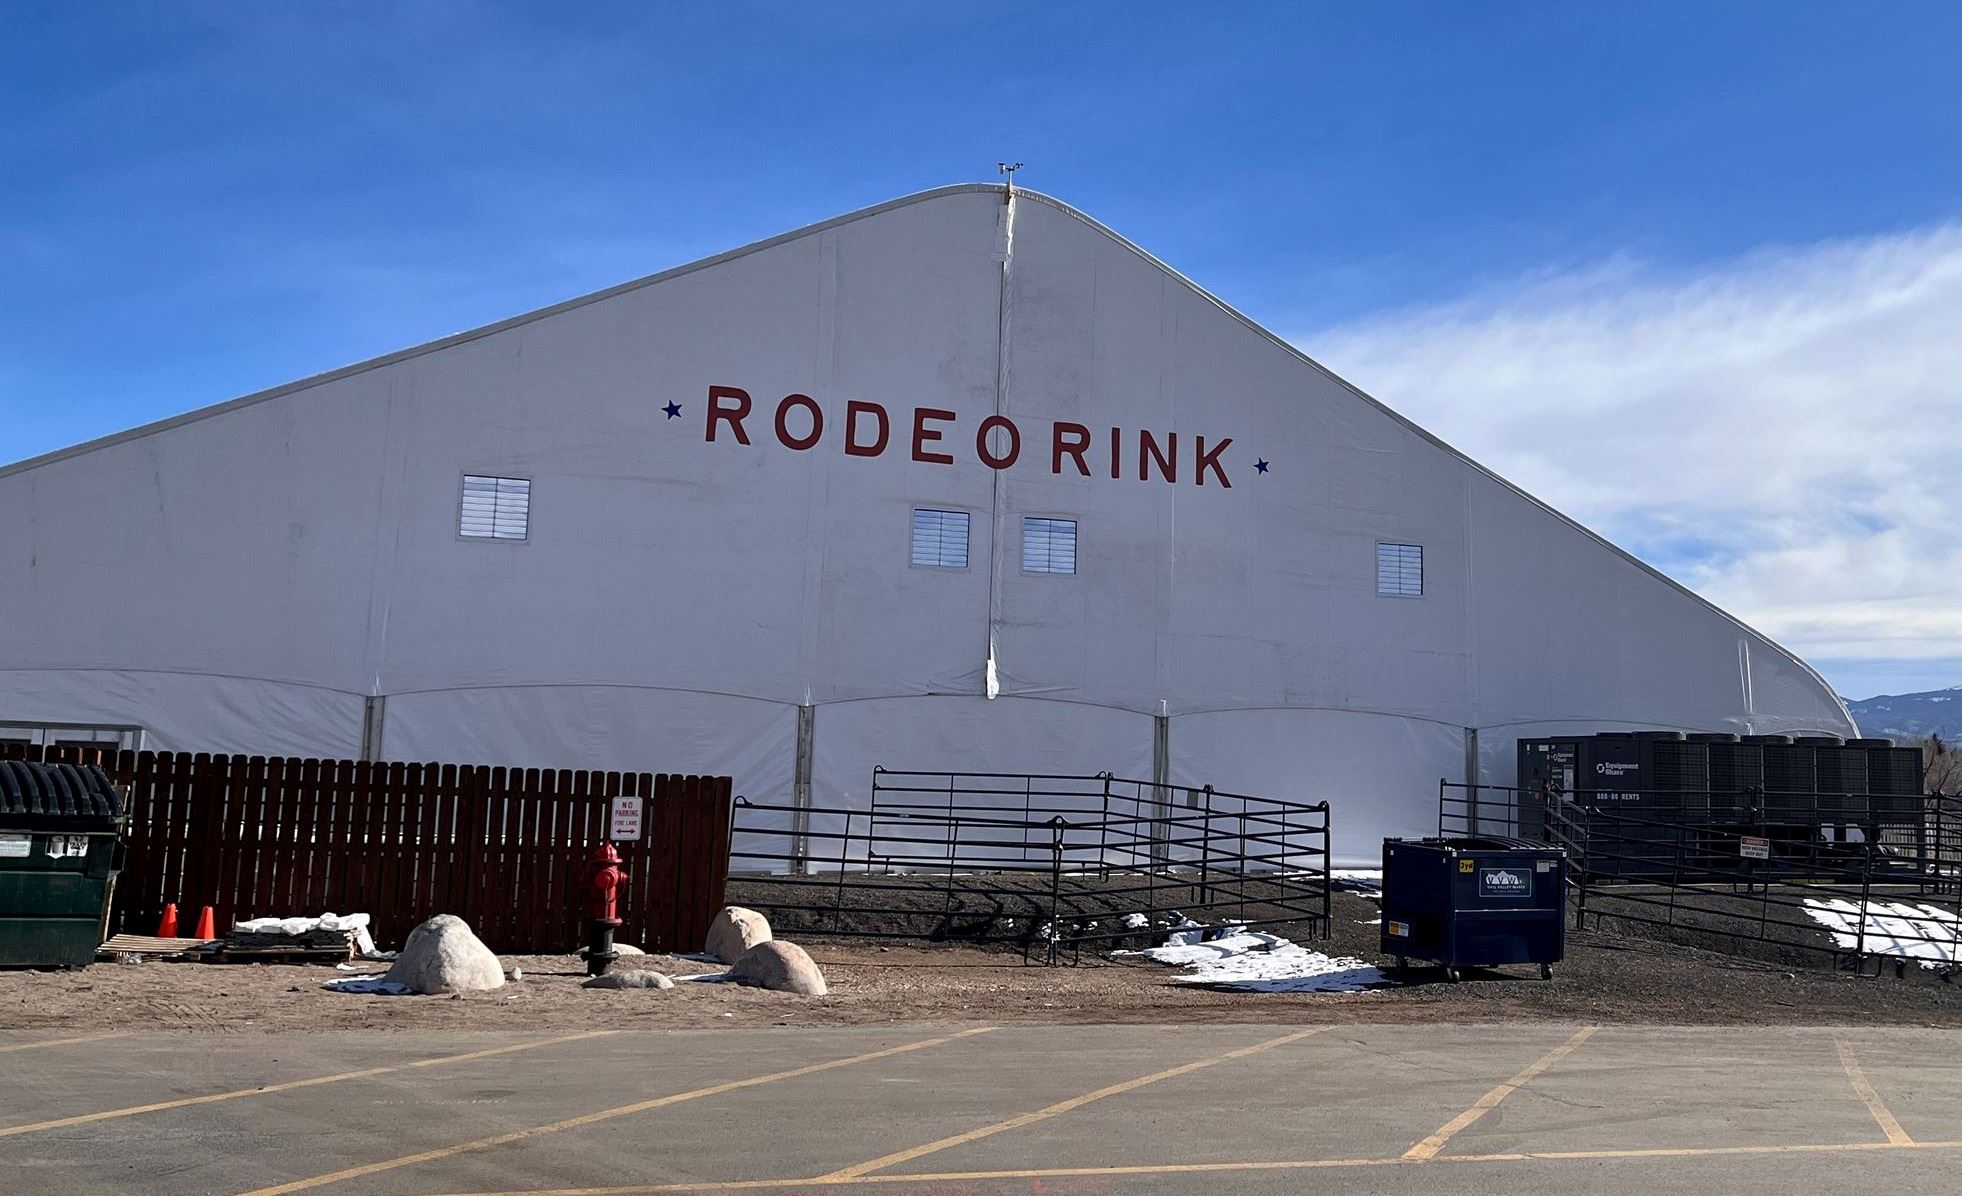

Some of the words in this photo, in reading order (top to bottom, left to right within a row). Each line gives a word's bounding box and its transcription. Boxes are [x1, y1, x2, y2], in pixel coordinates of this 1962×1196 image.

[705, 385, 1021, 470] RODEO
[1051, 421, 1234, 488] RINK
[1605, 762, 1639, 770] Equipment
[622, 801, 633, 809] NO
[615, 809, 639, 817] PARKING
